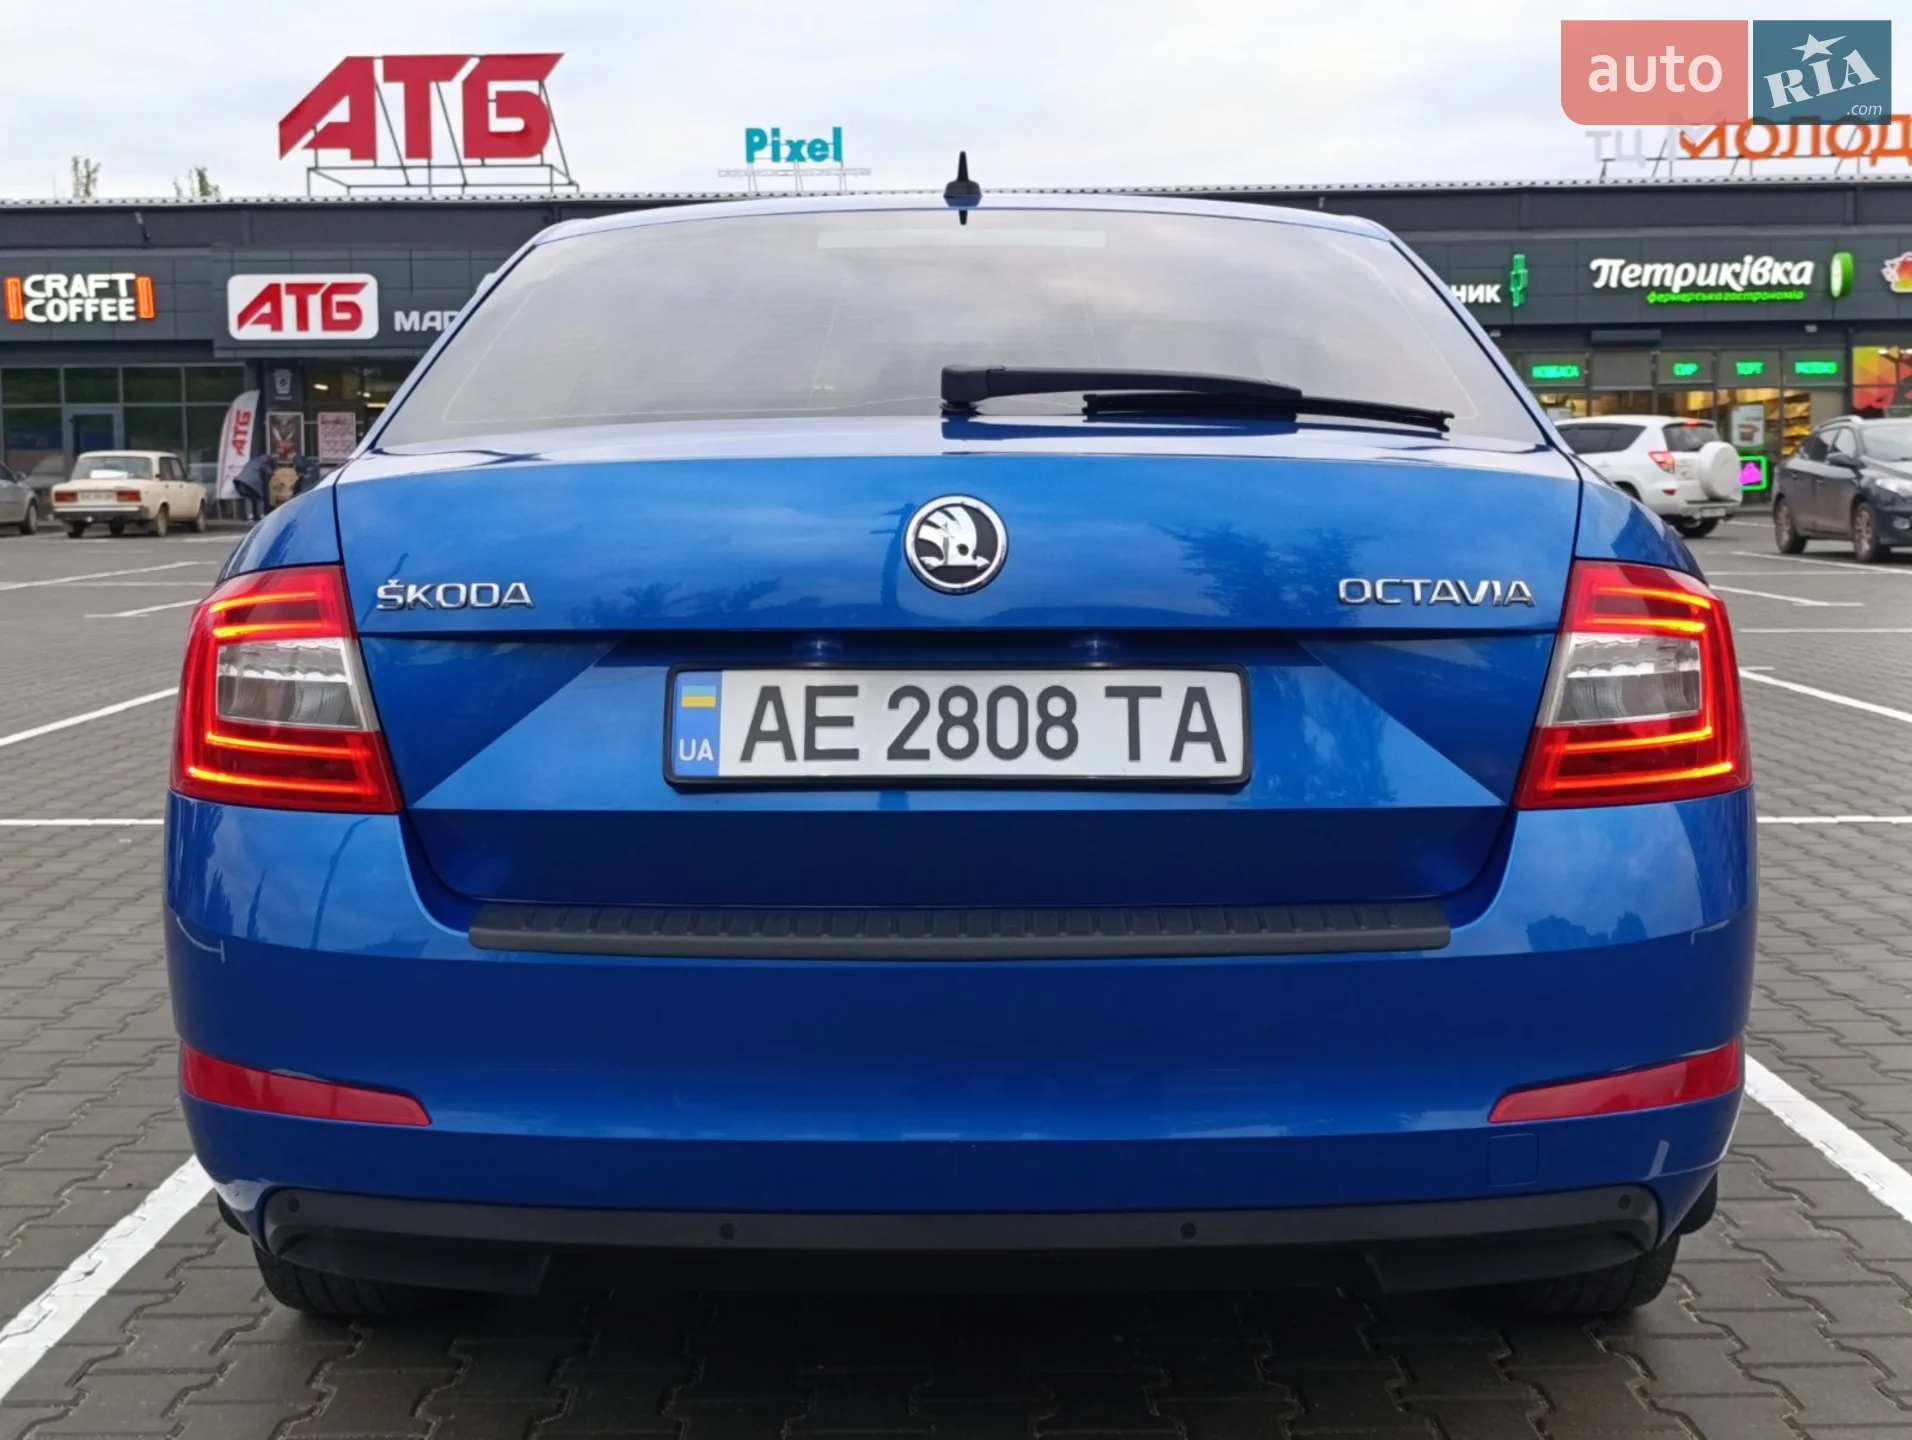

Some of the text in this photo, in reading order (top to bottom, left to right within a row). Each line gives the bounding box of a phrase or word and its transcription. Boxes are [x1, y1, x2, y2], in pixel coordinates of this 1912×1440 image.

[745, 126, 843, 163] Pixel
[23, 273, 136, 298] CRAFT
[24, 298, 137, 323] COFFEE
[376, 579, 535, 611] ŠKODA
[1338, 577, 1536, 607] OCTAVIA
[740, 685, 1227, 763] AE 2808 TA
[679, 738, 715, 762] UA
